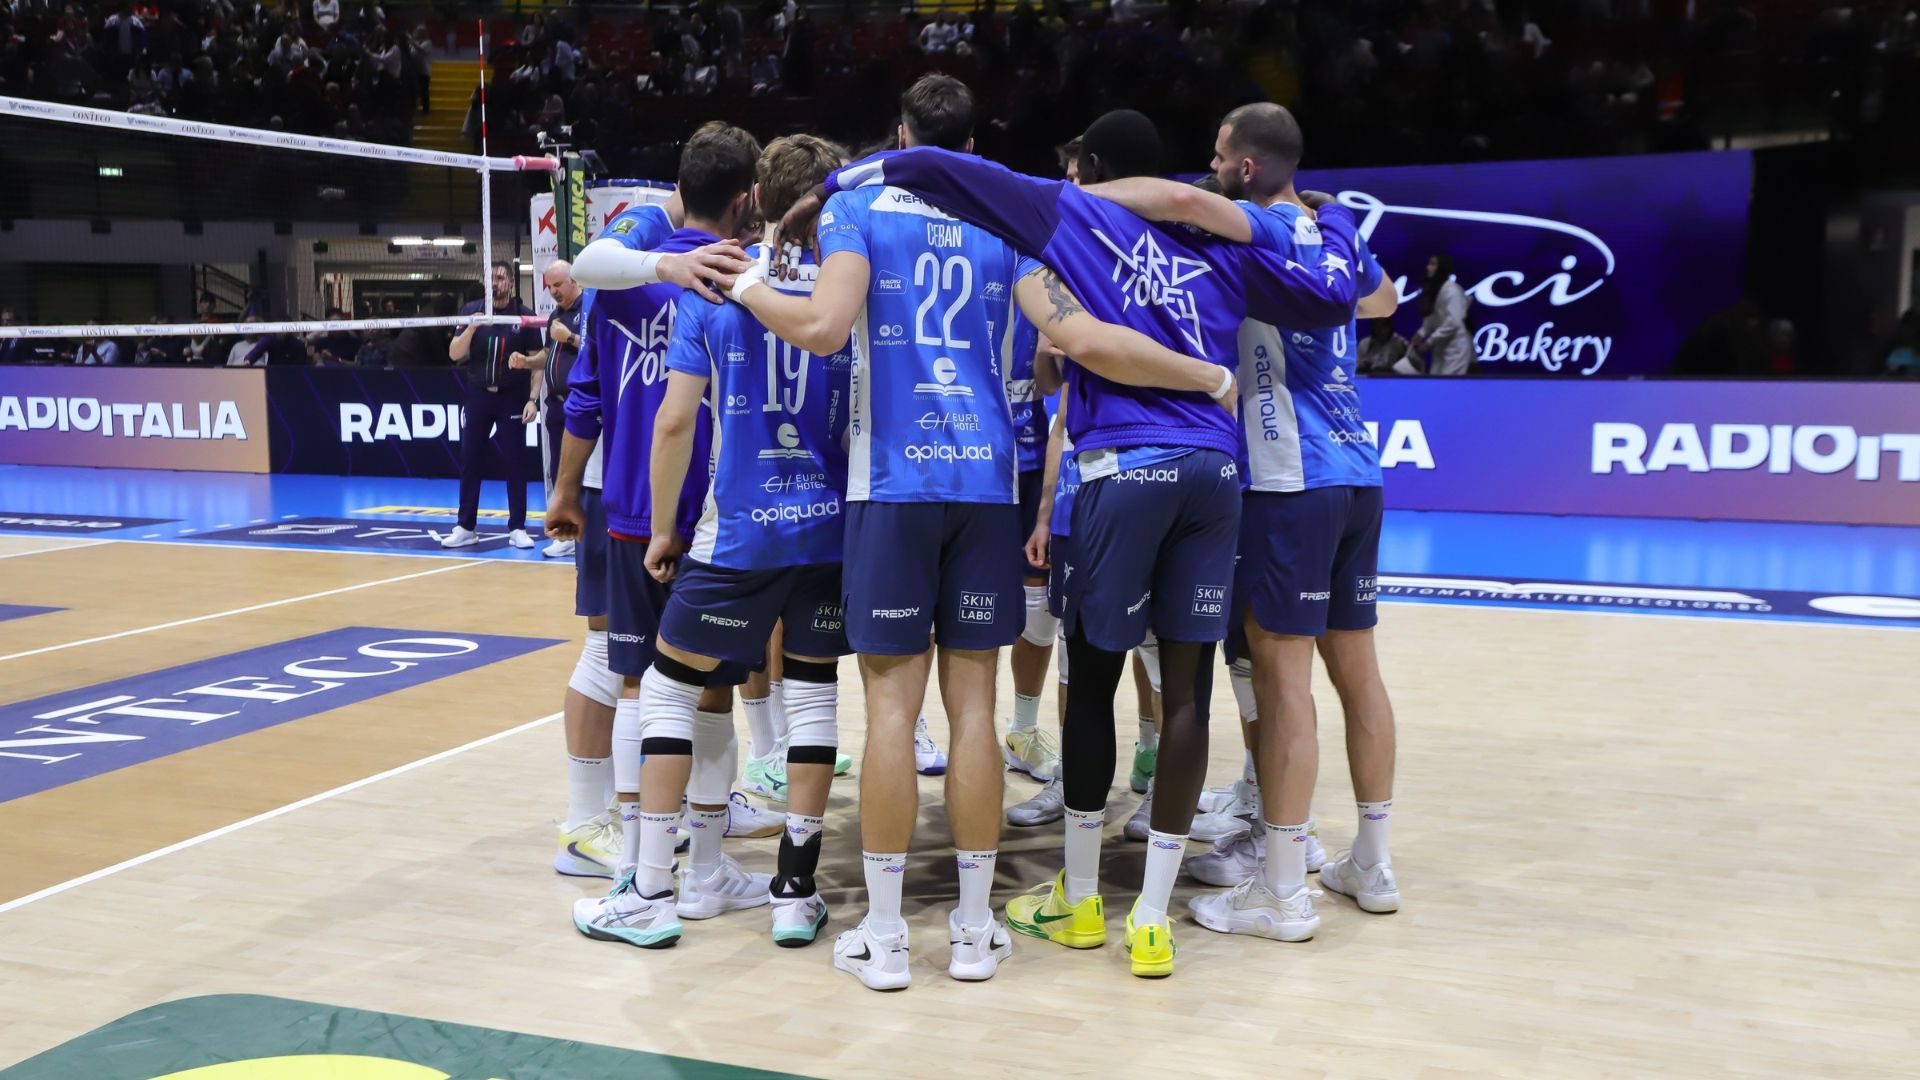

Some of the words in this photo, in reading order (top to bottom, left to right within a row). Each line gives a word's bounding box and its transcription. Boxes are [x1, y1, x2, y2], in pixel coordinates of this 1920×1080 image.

[72, 110, 111, 124] CONTECO
[571, 170, 586, 247] BANCA
[927, 222, 962, 248] CEBAN
[914, 251, 973, 349] 22
[1473, 321, 1613, 376] Bakery
[763, 330, 810, 415] 19
[0, 396, 248, 440] ADIOITALIA
[953, 413, 979, 422] EURO
[953, 422, 981, 432] HOTEL
[1591, 422, 1920, 481] RADIOIT
[795, 473, 825, 482] EURO
[796, 482, 827, 491] HOTEL
[962, 594, 993, 607] SKIN
[1196, 588, 1224, 600] SKIN
[872, 606, 920, 619] FREDDY
[1194, 602, 1221, 614] LABO
[701, 613, 749, 628] FREDDY
[961, 609, 992, 621] LABO
[813, 619, 841, 631] LABO
[609, 632, 646, 644] FREDDY
[0, 637, 479, 765] NTECO
